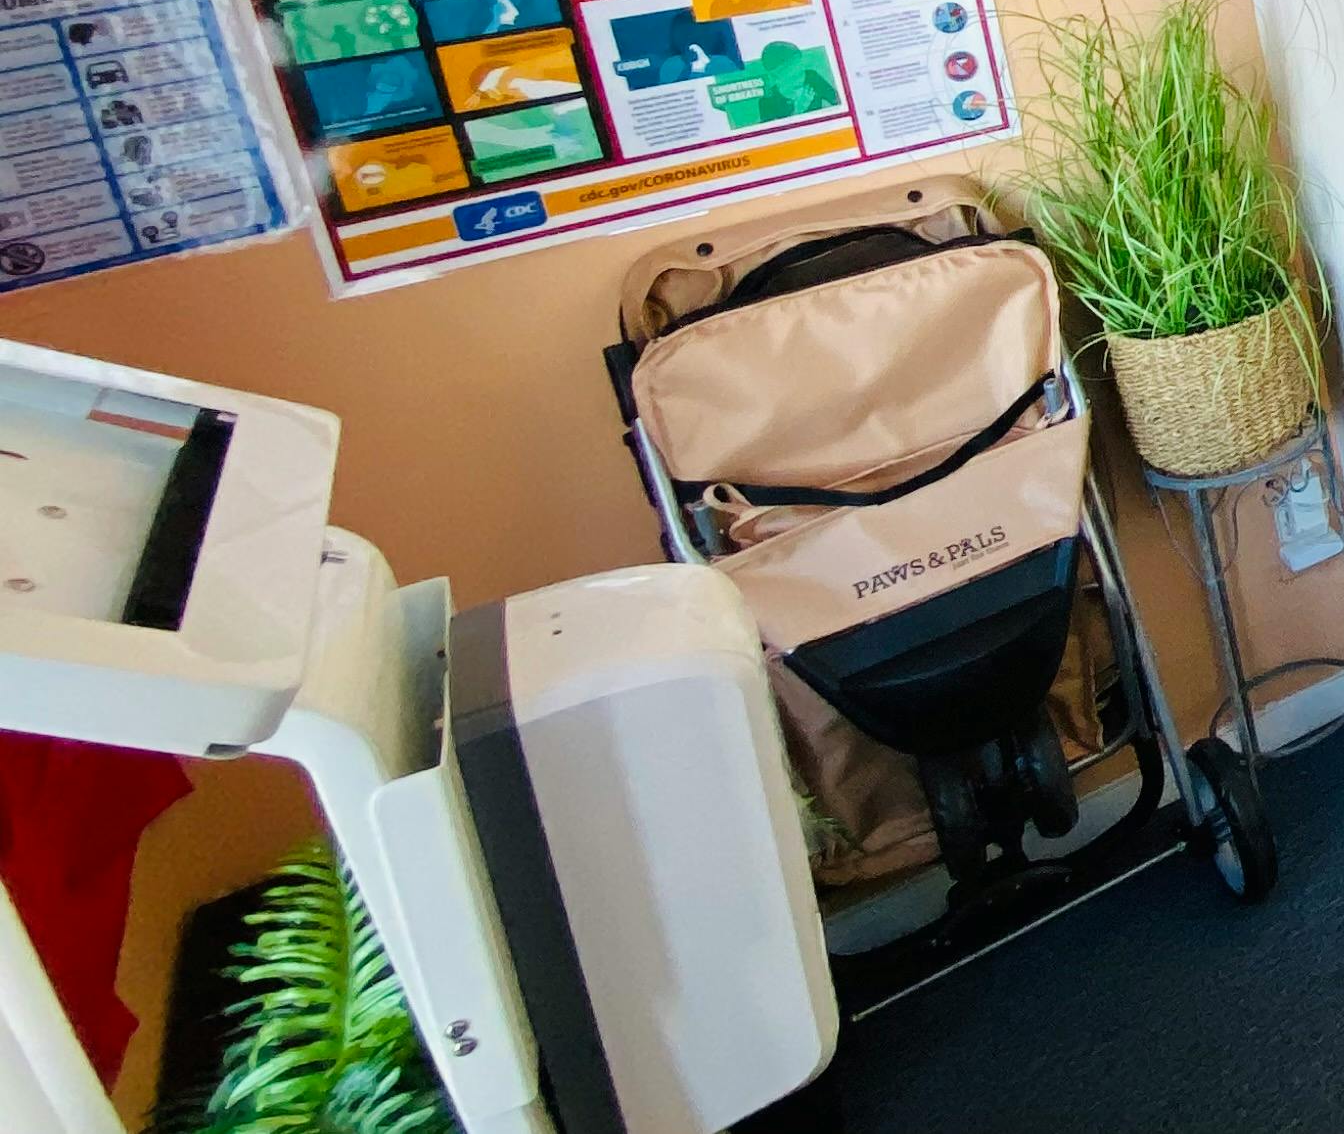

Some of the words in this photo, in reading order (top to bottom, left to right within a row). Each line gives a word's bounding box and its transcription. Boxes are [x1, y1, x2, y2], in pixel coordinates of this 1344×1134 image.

[578, 155, 751, 203] cdc.gov/CORONAVIRUS
[505, 202, 536, 219] CDC
[852, 558, 926, 599] PAWS
[928, 551, 945, 569] &
[945, 526, 1006, 561] PALS
